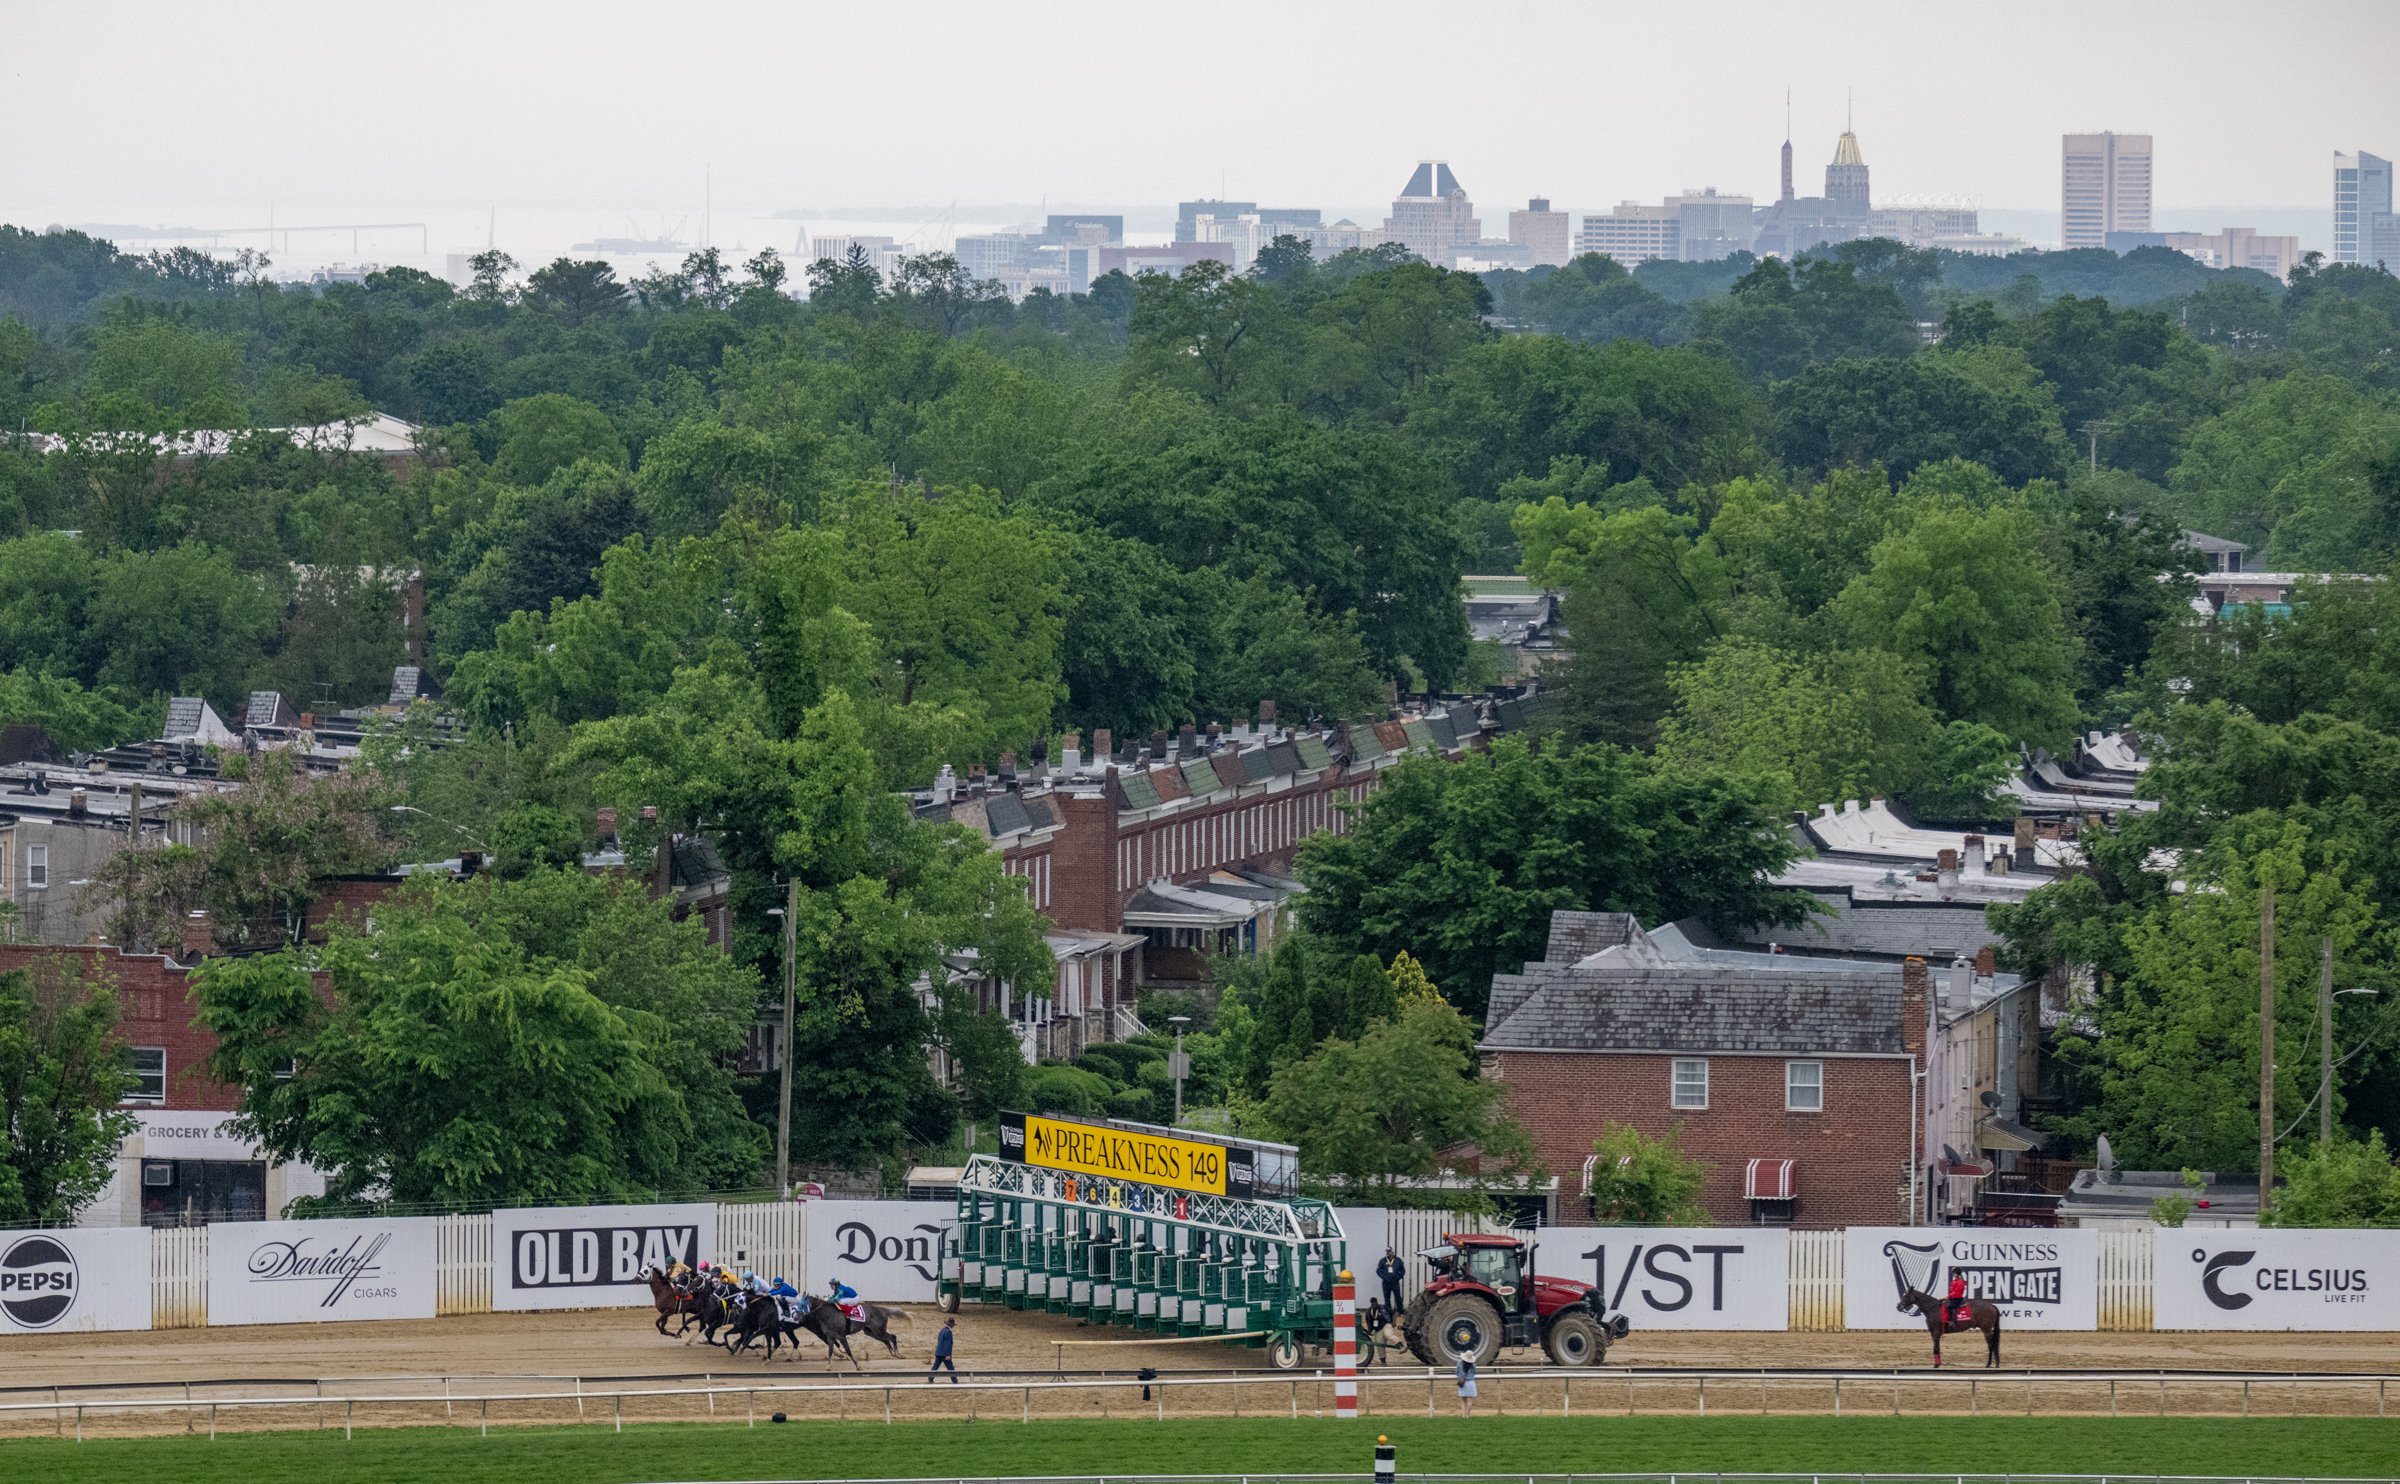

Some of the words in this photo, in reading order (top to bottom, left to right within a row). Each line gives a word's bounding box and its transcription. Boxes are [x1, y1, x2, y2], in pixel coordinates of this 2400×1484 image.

[148, 1127, 209, 1139] GROCERY
[213, 1127, 223, 1139] &
[1055, 1129, 1180, 1179] PREAKNESS
[1187, 1151, 1218, 1185] 149
[1068, 1184, 1074, 1197] 7
[1089, 1188, 1096, 1201] 6
[1112, 1191, 1118, 1204] 4
[1134, 1194, 1140, 1208] 3
[1156, 1199, 1162, 1212] 2
[1179, 1202, 1184, 1216] 1
[835, 1221, 931, 1264] Don
[1952, 1241, 2058, 1261] GUINNESS
[518, 1231, 599, 1285] OLD
[612, 1228, 692, 1282] BAY
[248, 1233, 391, 1307] Davidoff
[1581, 1244, 1744, 1312] 1/ST
[1, 1271, 72, 1291] PEPSI
[2013, 1270, 2058, 1300] GATE
[2256, 1268, 2367, 1292] CELSIUS
[354, 1288, 397, 1298] CIGARS
[2324, 1295, 2346, 1303] LIVE
[2350, 1295, 2366, 1303] FIT
